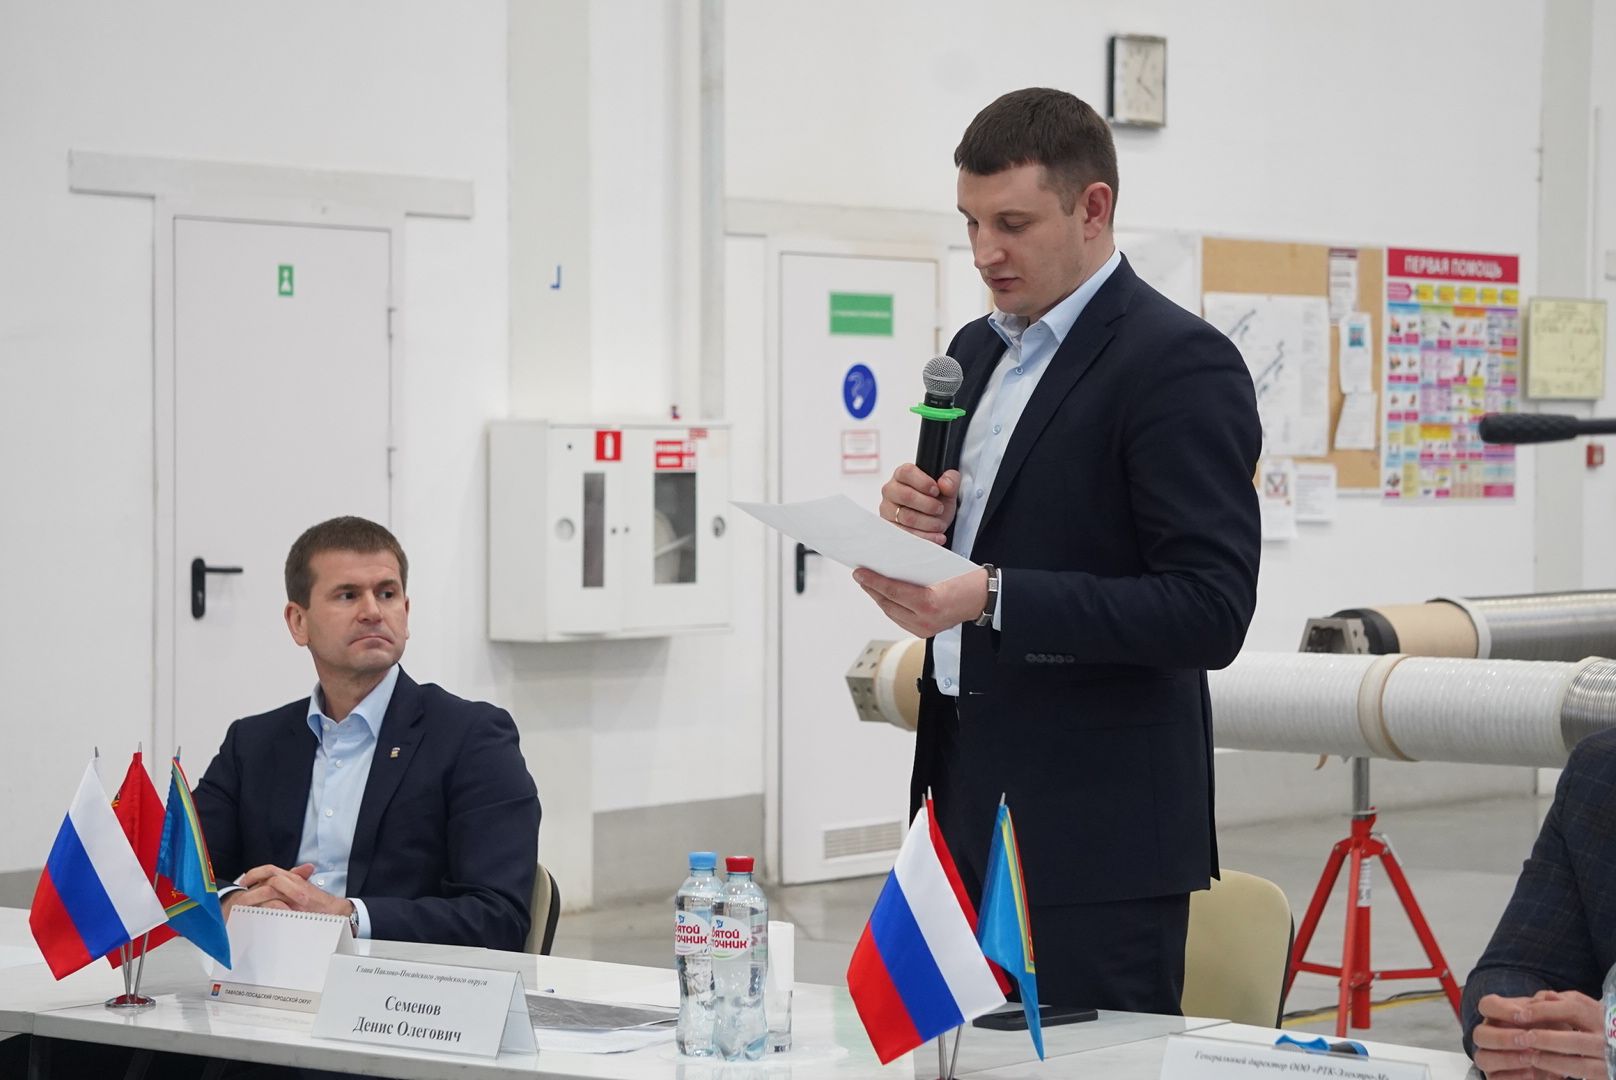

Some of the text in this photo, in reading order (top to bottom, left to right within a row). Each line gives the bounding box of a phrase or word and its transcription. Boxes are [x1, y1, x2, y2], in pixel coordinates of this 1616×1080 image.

[1404, 255, 1503, 279] ПЕРВАЯ ПОМОЩЬ
[384, 995, 441, 1016] Семенов
[352, 1016, 462, 1042] Денис Олегович
